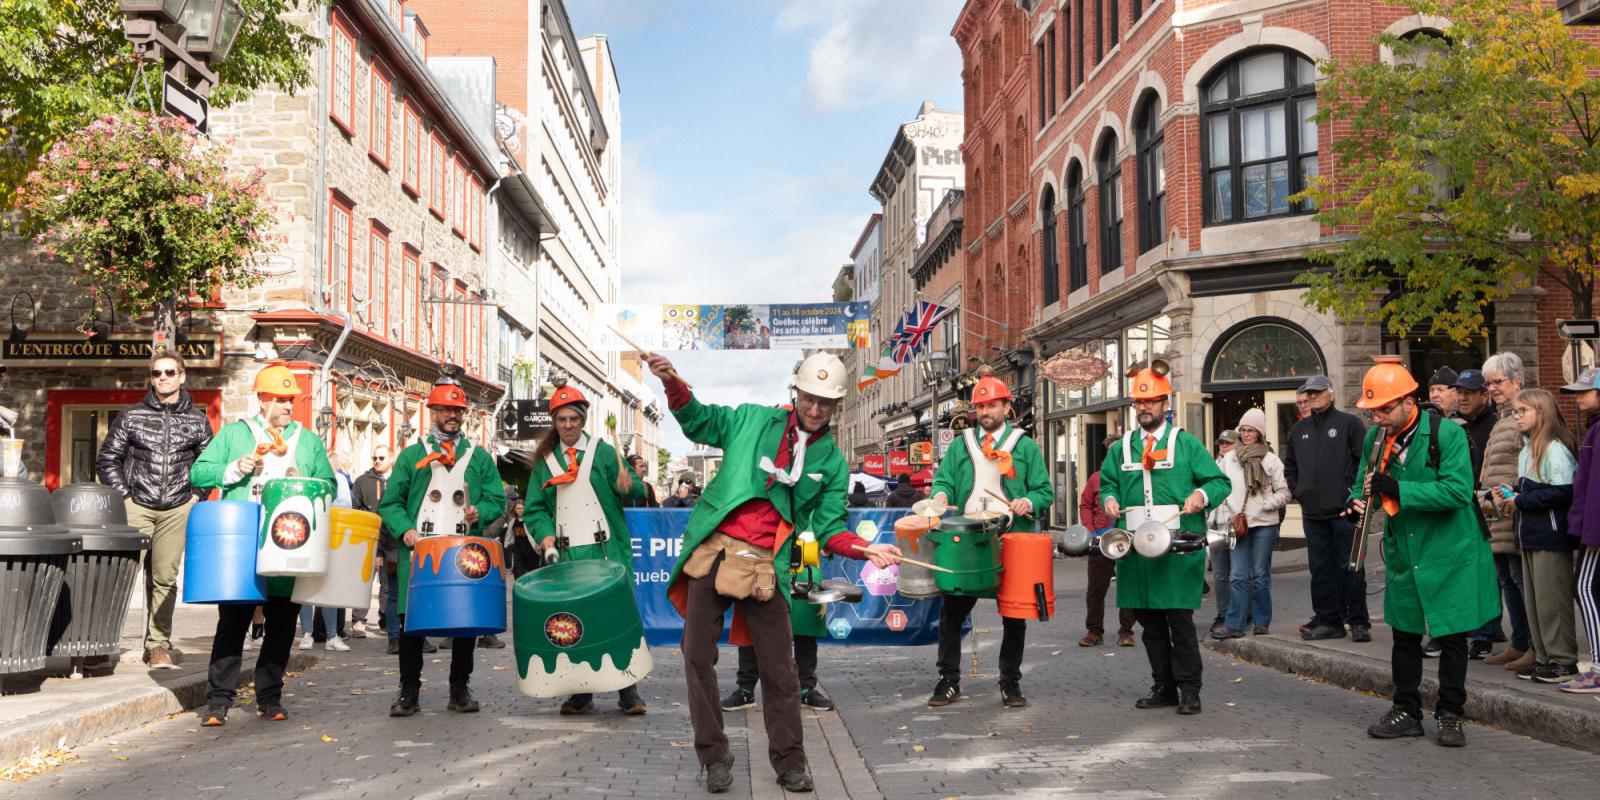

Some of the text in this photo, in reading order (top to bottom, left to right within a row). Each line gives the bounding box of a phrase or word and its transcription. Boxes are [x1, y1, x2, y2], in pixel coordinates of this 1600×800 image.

[773, 308, 781, 317] 11
[791, 308, 800, 316] 14
[801, 307, 824, 316] octobre
[825, 306, 842, 315] 2024
[772, 316, 828, 327] Québec célèbre
[773, 326, 783, 335] les
[801, 325, 810, 334] de
[811, 325, 819, 333] la
[9, 341, 208, 356] L'ENTRECÔTE SAIN EAN
